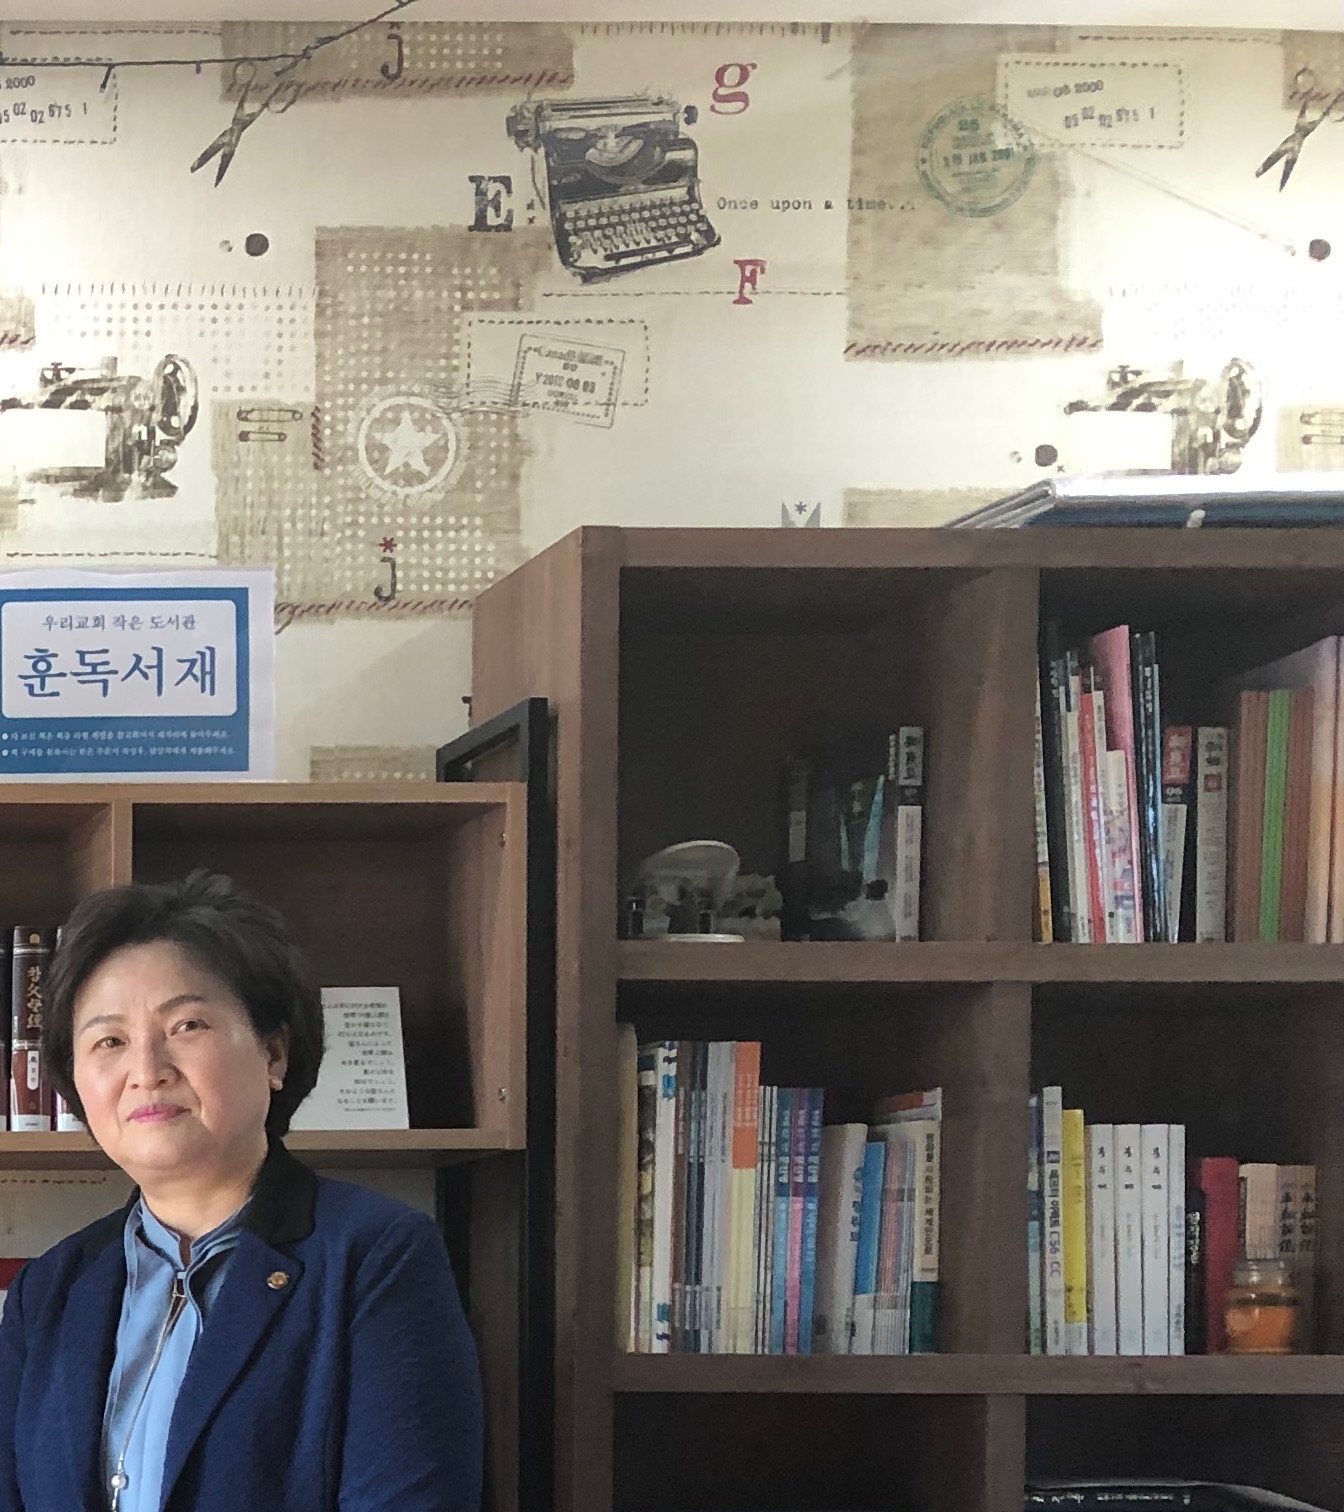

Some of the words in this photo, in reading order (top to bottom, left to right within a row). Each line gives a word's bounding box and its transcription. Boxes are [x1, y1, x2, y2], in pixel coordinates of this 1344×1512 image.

[710, 61, 759, 114] g
[467, 174, 514, 233] E
[716, 195, 761, 212] Once
[769, 197, 814, 216] upon
[731, 258, 766, 305] F
[41, 613, 106, 632] 우리교회
[111, 613, 144, 632] 작은
[149, 613, 197, 632] 도서관
[17, 645, 217, 699] 훈독서재
